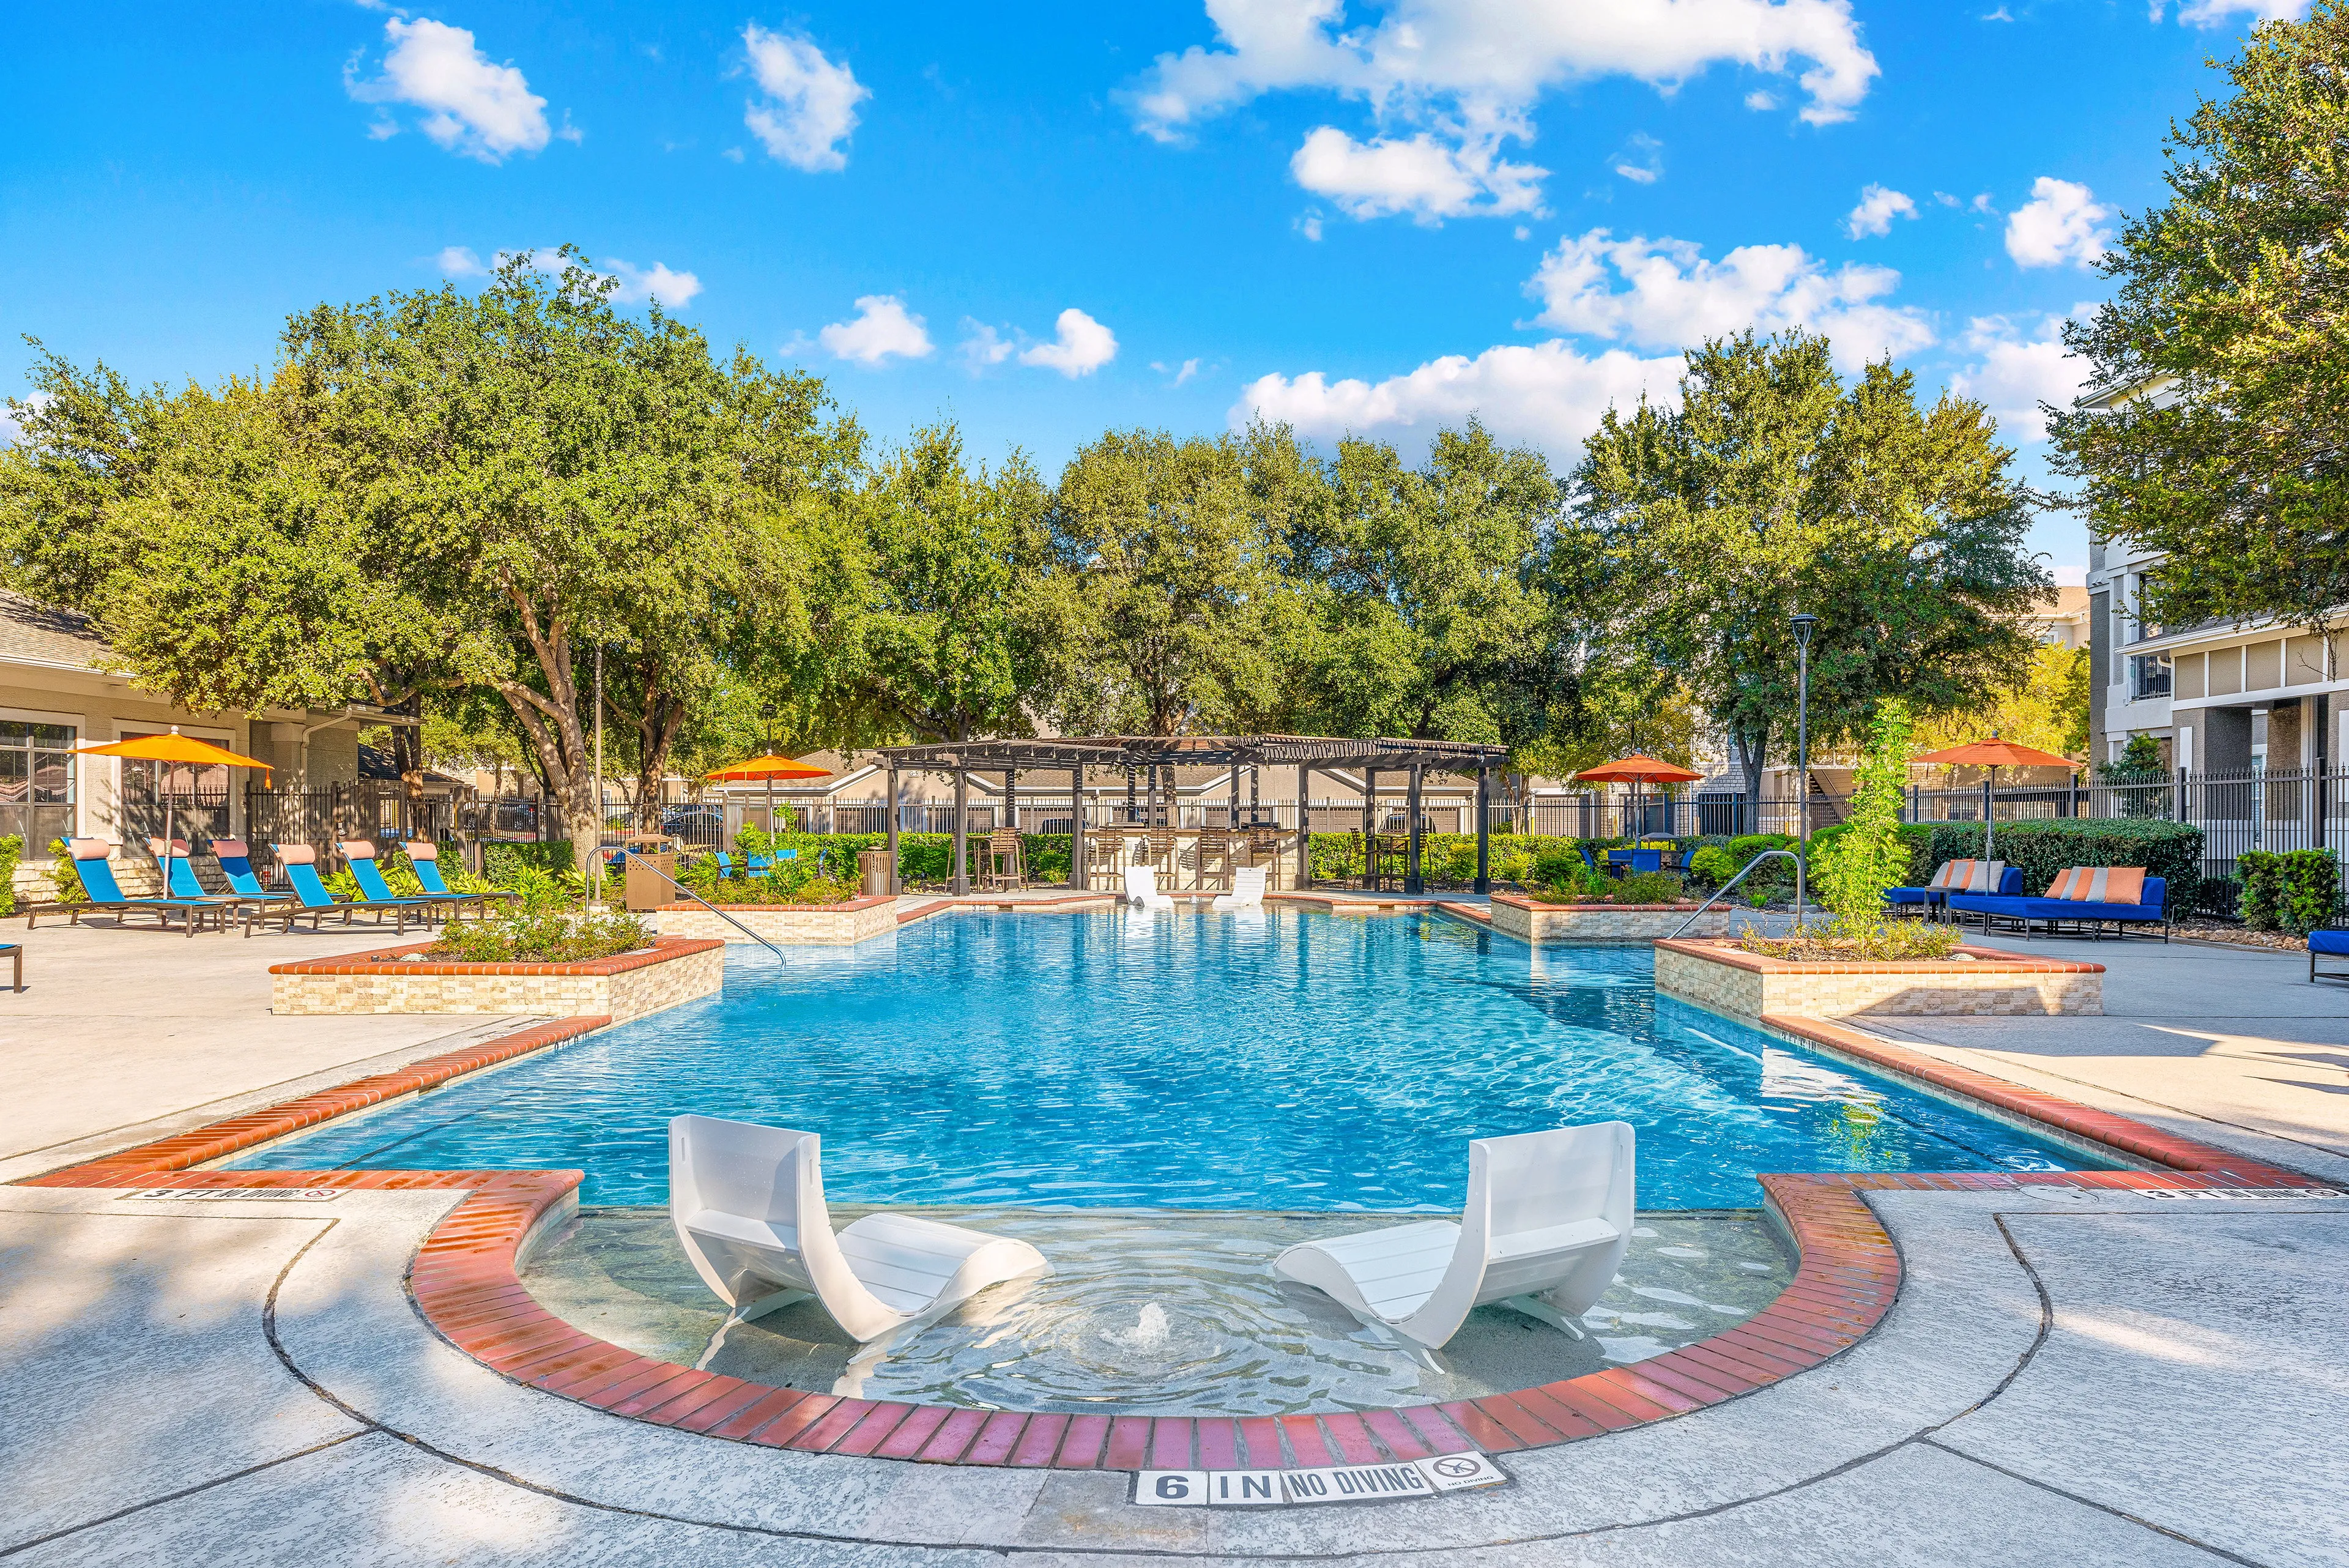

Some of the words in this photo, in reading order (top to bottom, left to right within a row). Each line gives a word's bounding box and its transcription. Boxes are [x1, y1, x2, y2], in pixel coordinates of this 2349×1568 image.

[1156, 1475, 1189, 1499] 6
[1220, 1476, 1272, 1498] IN
[1288, 1473, 1327, 1497] NO
[1332, 1468, 1425, 1494] DIVING
